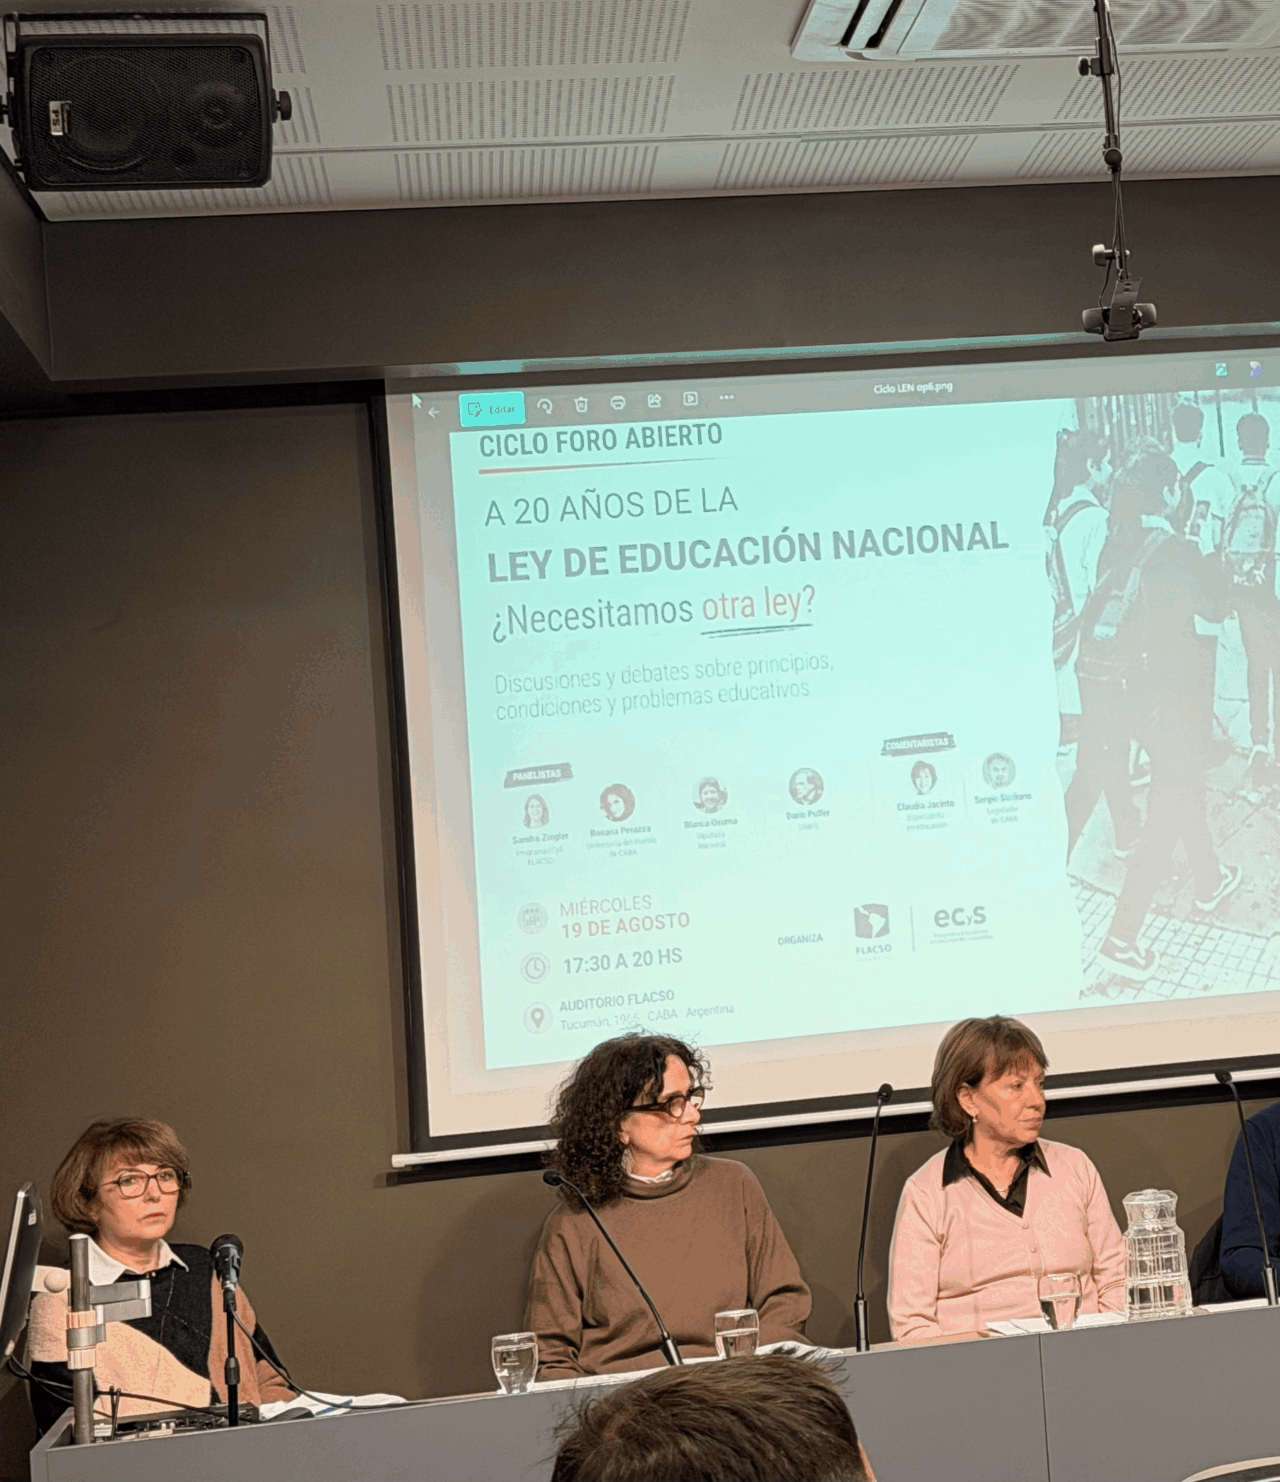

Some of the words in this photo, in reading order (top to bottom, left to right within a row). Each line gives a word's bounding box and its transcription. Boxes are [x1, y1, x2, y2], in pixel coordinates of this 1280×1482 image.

[897, 383, 915, 393] LEN
[479, 431, 549, 458] CICLO
[556, 428, 618, 453] FORO
[625, 422, 723, 450] ABIERTO
[484, 500, 506, 527] A
[514, 497, 550, 525] 20
[559, 488, 645, 522] AÑOS
[654, 488, 693, 516] DE
[701, 486, 739, 513] LA
[488, 549, 553, 583] LEY
[564, 545, 610, 577] DE
[619, 526, 822, 574] EDUCACIÓN
[832, 521, 1010, 560] NACIONAL
[492, 598, 694, 643] ¿Necesitamos
[702, 592, 757, 621] otra
[764, 584, 816, 623] ley?
[494, 671, 601, 694] Discusiones
[606, 672, 616, 691] y
[620, 664, 690, 685] debates
[694, 658, 743, 680] sobre
[748, 651, 834, 680] principios,
[496, 697, 602, 721] condiciones
[607, 697, 618, 717] y
[622, 689, 714, 714] problemas
[717, 680, 810, 704] educativos
[885, 737, 949, 751] COMENTARISTAS
[512, 769, 562, 782] PANELISTAS
[897, 802, 926, 812] Claudia
[927, 799, 955, 810] Jacinto
[512, 834, 539, 845] Sandra
[590, 827, 619, 838] Rosana
[620, 825, 652, 835] Perazza
[559, 894, 653, 918] MIÉRCOLES
[561, 922, 583, 939] 19
[588, 920, 612, 937] DE
[615, 912, 691, 935] AGOSTO
[777, 933, 824, 946] ORGANIZA
[855, 944, 892, 955] FLACSO
[563, 954, 611, 975] 17:30
[615, 953, 629, 969] A
[632, 950, 654, 967] 20
[658, 947, 683, 965] HS
[559, 994, 625, 1013] AUDITORIO
[627, 989, 675, 1006] FLACSO
[647, 1009, 678, 1022] CABA
[685, 1003, 735, 1018] Argentina
